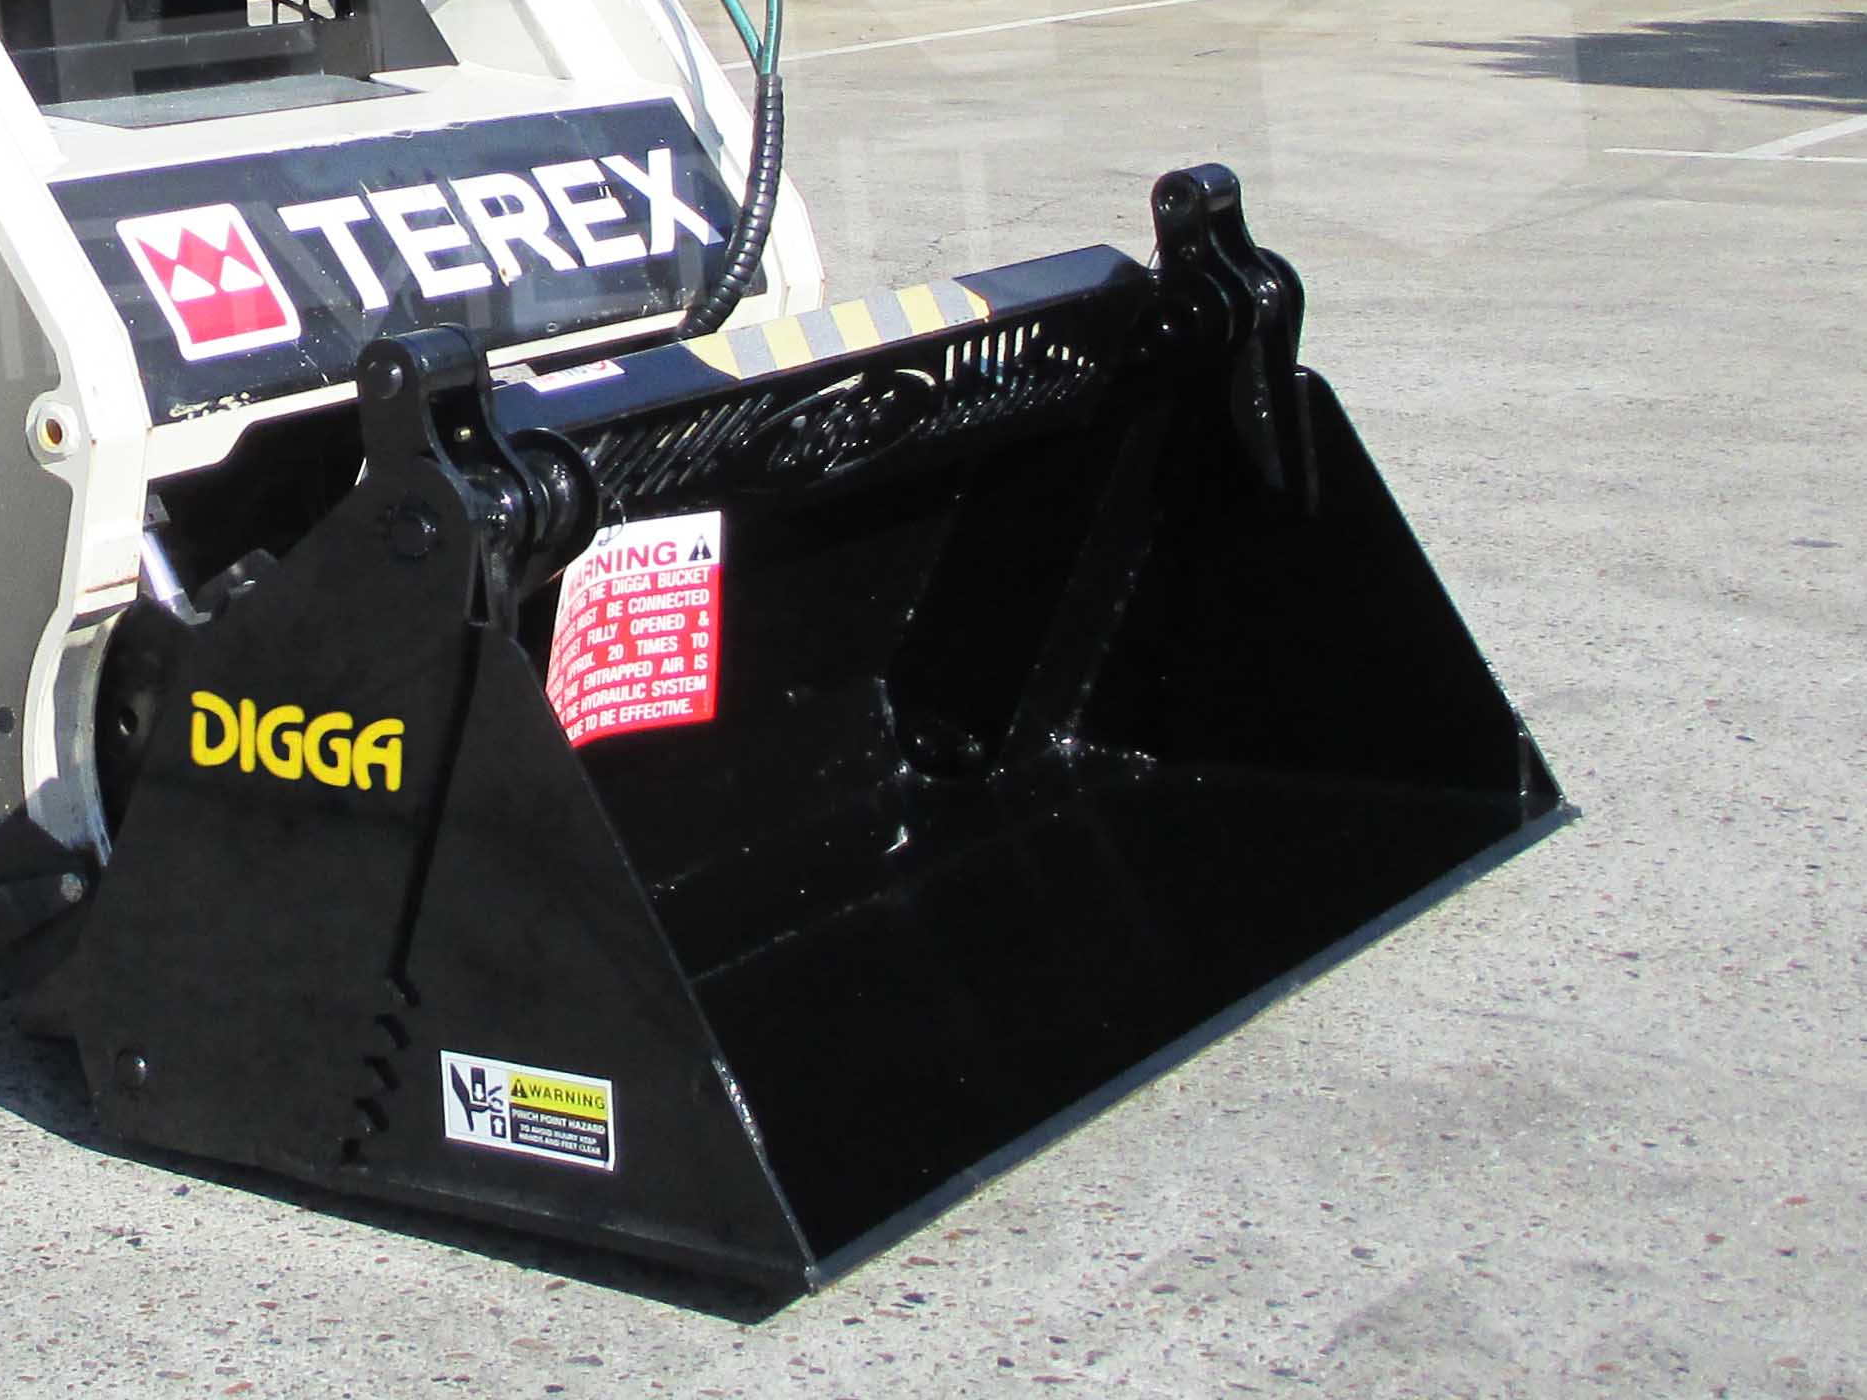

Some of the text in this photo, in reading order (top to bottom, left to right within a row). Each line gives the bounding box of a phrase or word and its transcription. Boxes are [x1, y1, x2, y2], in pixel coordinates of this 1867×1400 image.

[276, 147, 727, 312] TEREX
[611, 574, 652, 597] DIGGA
[657, 567, 709, 590] BUCKET
[606, 600, 624, 619] BE
[627, 588, 710, 615] CONNECTED
[586, 622, 619, 647] FULLY
[630, 612, 686, 636] OPENED
[697, 609, 710, 627] &
[607, 643, 625, 662] 20
[635, 635, 679, 657] TIMES
[690, 631, 710, 649] TO
[582, 660, 654, 692] ENTRAPPED
[660, 655, 685, 675] AIR
[693, 652, 709, 671] IS
[580, 681, 647, 714] HYDRAULIC
[651, 674, 708, 698] SYSTEM
[599, 707, 618, 728] BE
[191, 691, 405, 793] DIGGA
[529, 1083, 606, 1111] WARNING
[540, 1112, 568, 1128] POINT
[568, 1119, 607, 1135] HAZARD
